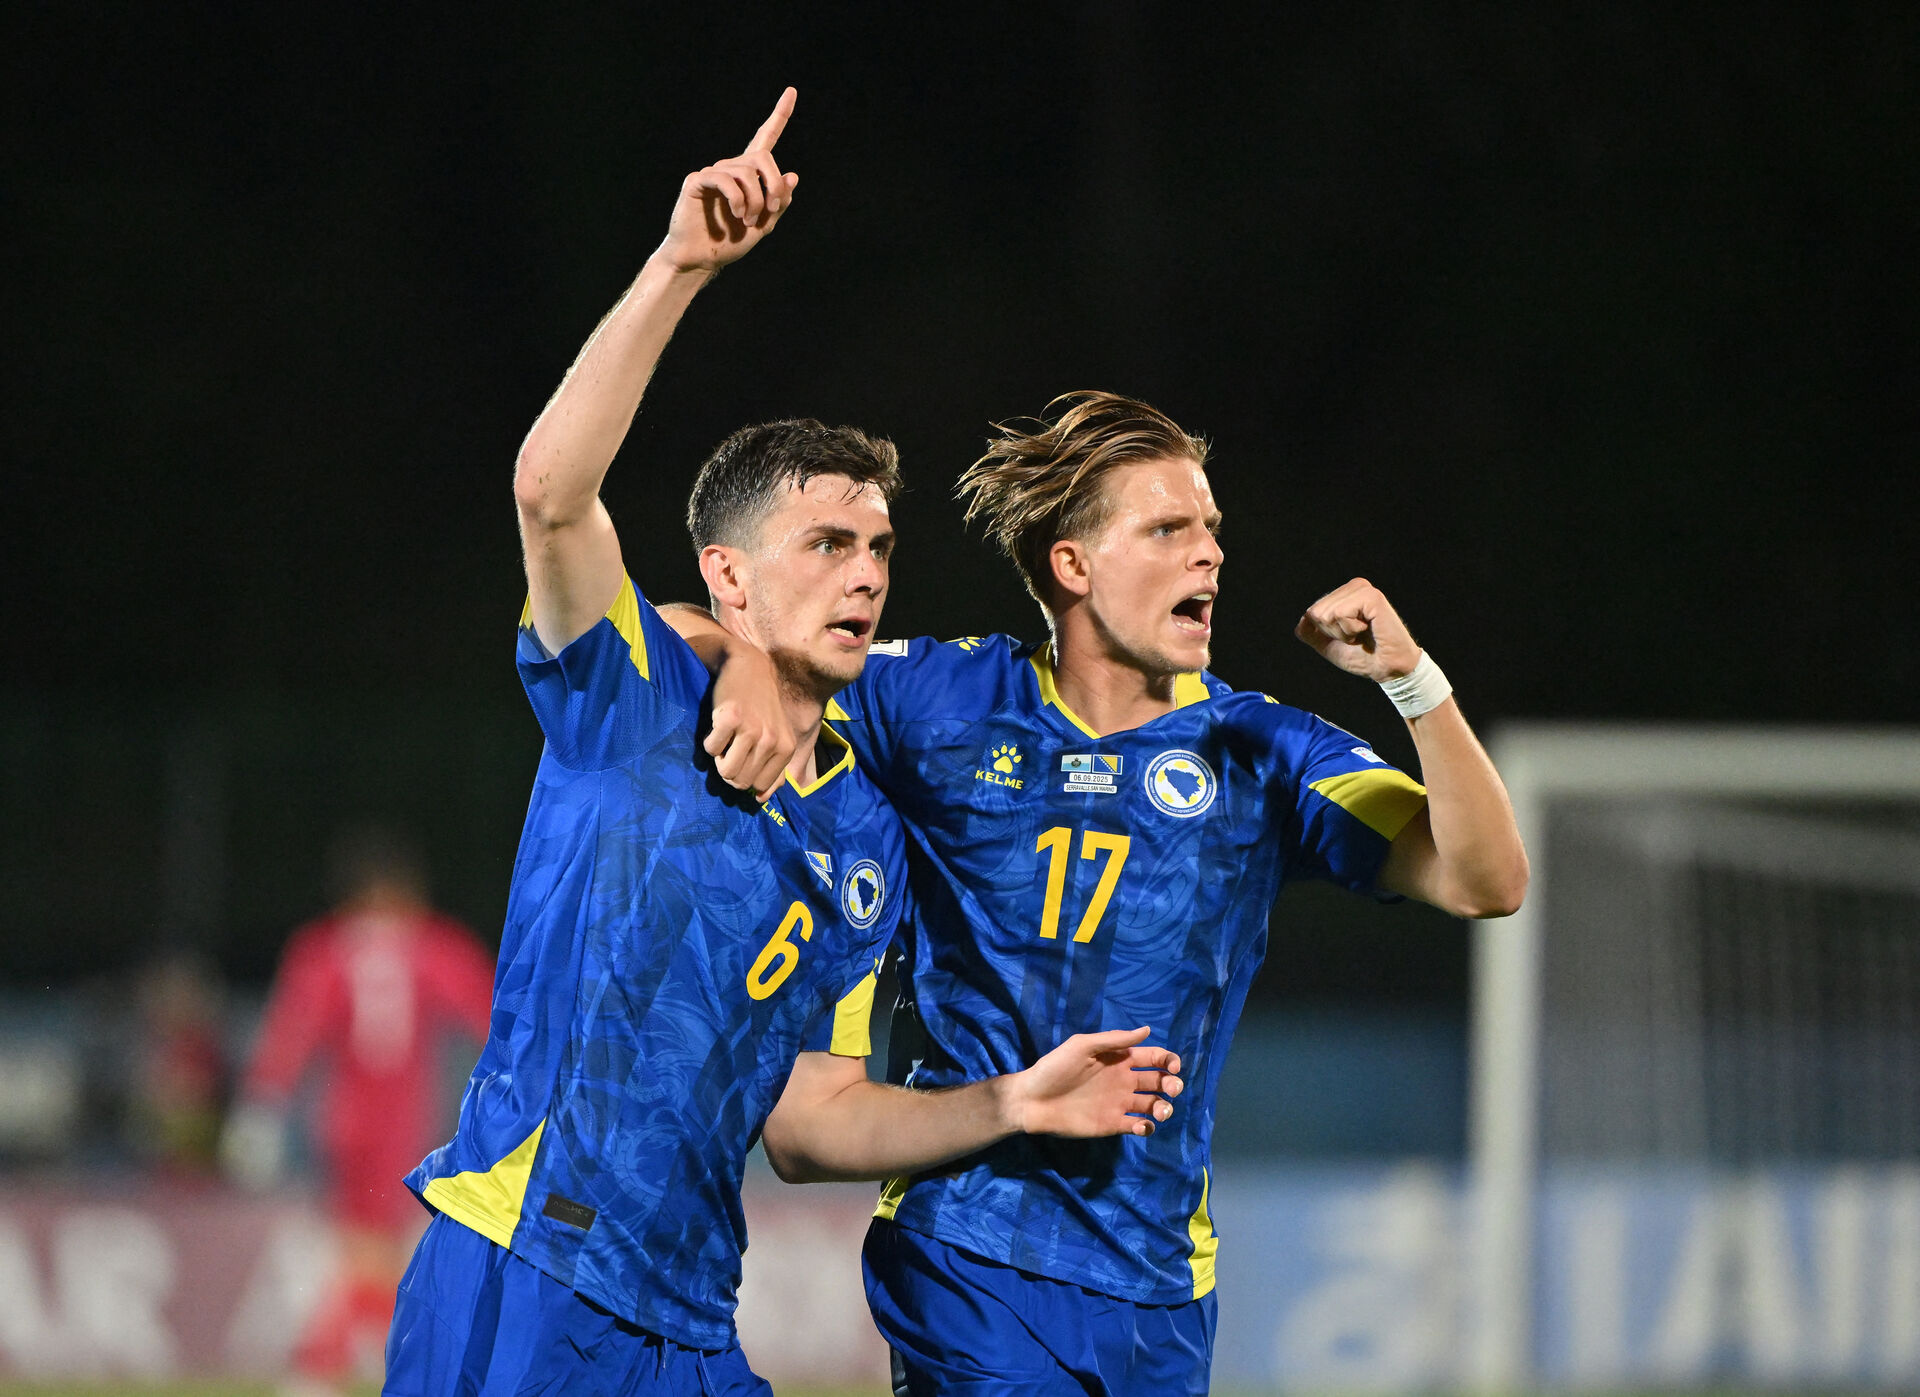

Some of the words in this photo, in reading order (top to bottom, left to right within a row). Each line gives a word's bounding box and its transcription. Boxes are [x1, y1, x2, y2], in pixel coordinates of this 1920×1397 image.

[975, 769, 1024, 790] KELME
[1073, 774, 1109, 783] 06.09.2025
[761, 801, 786, 827] LME
[1036, 827, 1131, 944] 17
[746, 901, 814, 1000] 6
